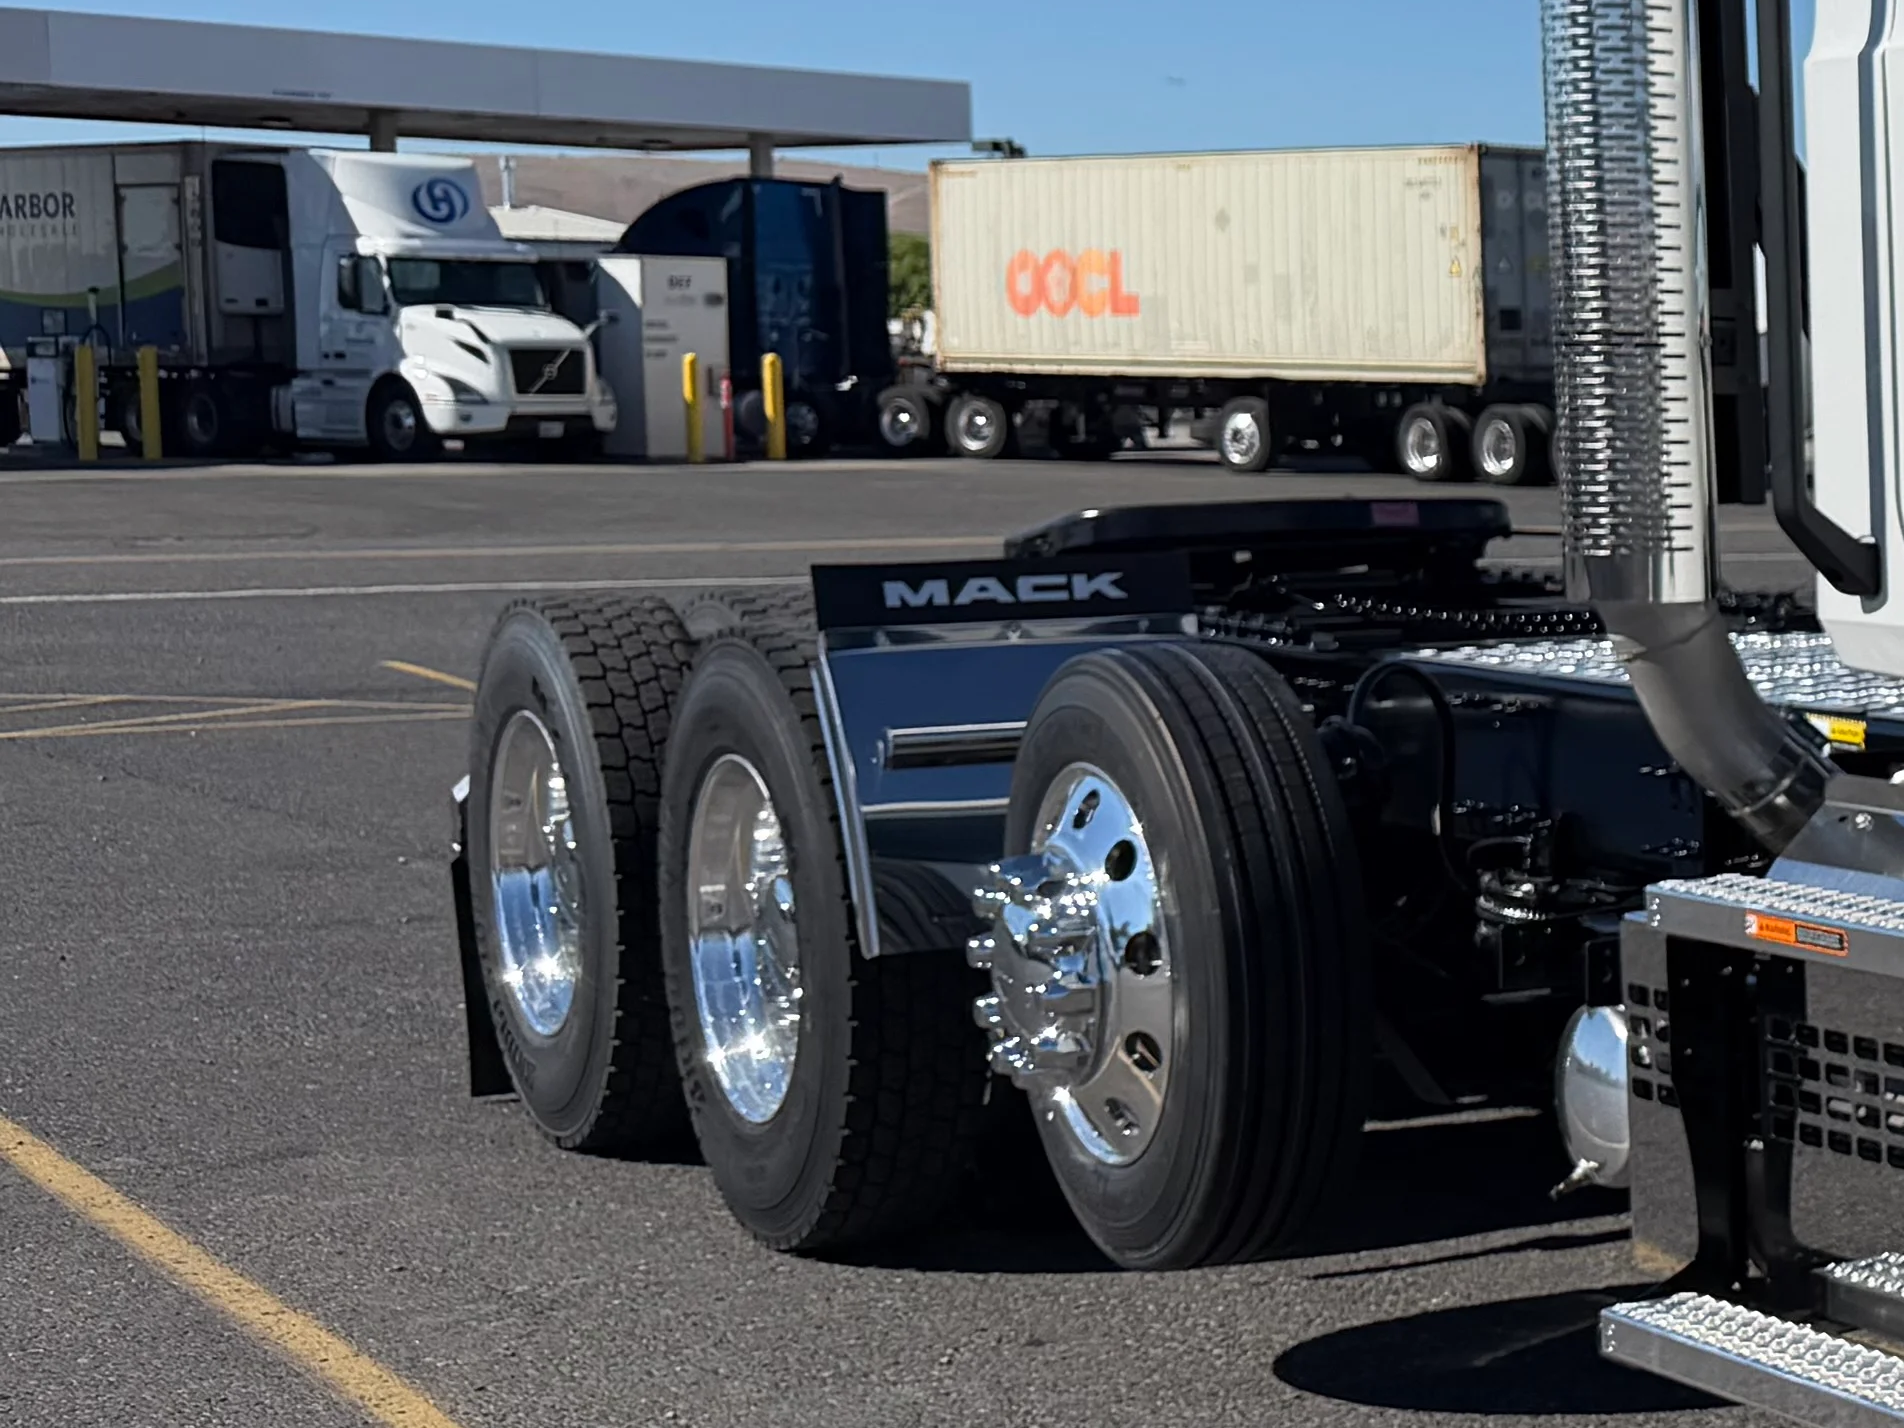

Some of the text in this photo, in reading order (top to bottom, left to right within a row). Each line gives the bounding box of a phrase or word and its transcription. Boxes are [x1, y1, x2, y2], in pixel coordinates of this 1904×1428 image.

[0, 192, 76, 220] ARBOR
[1006, 248, 1140, 317] OOCL
[883, 572, 1128, 608] MACK
